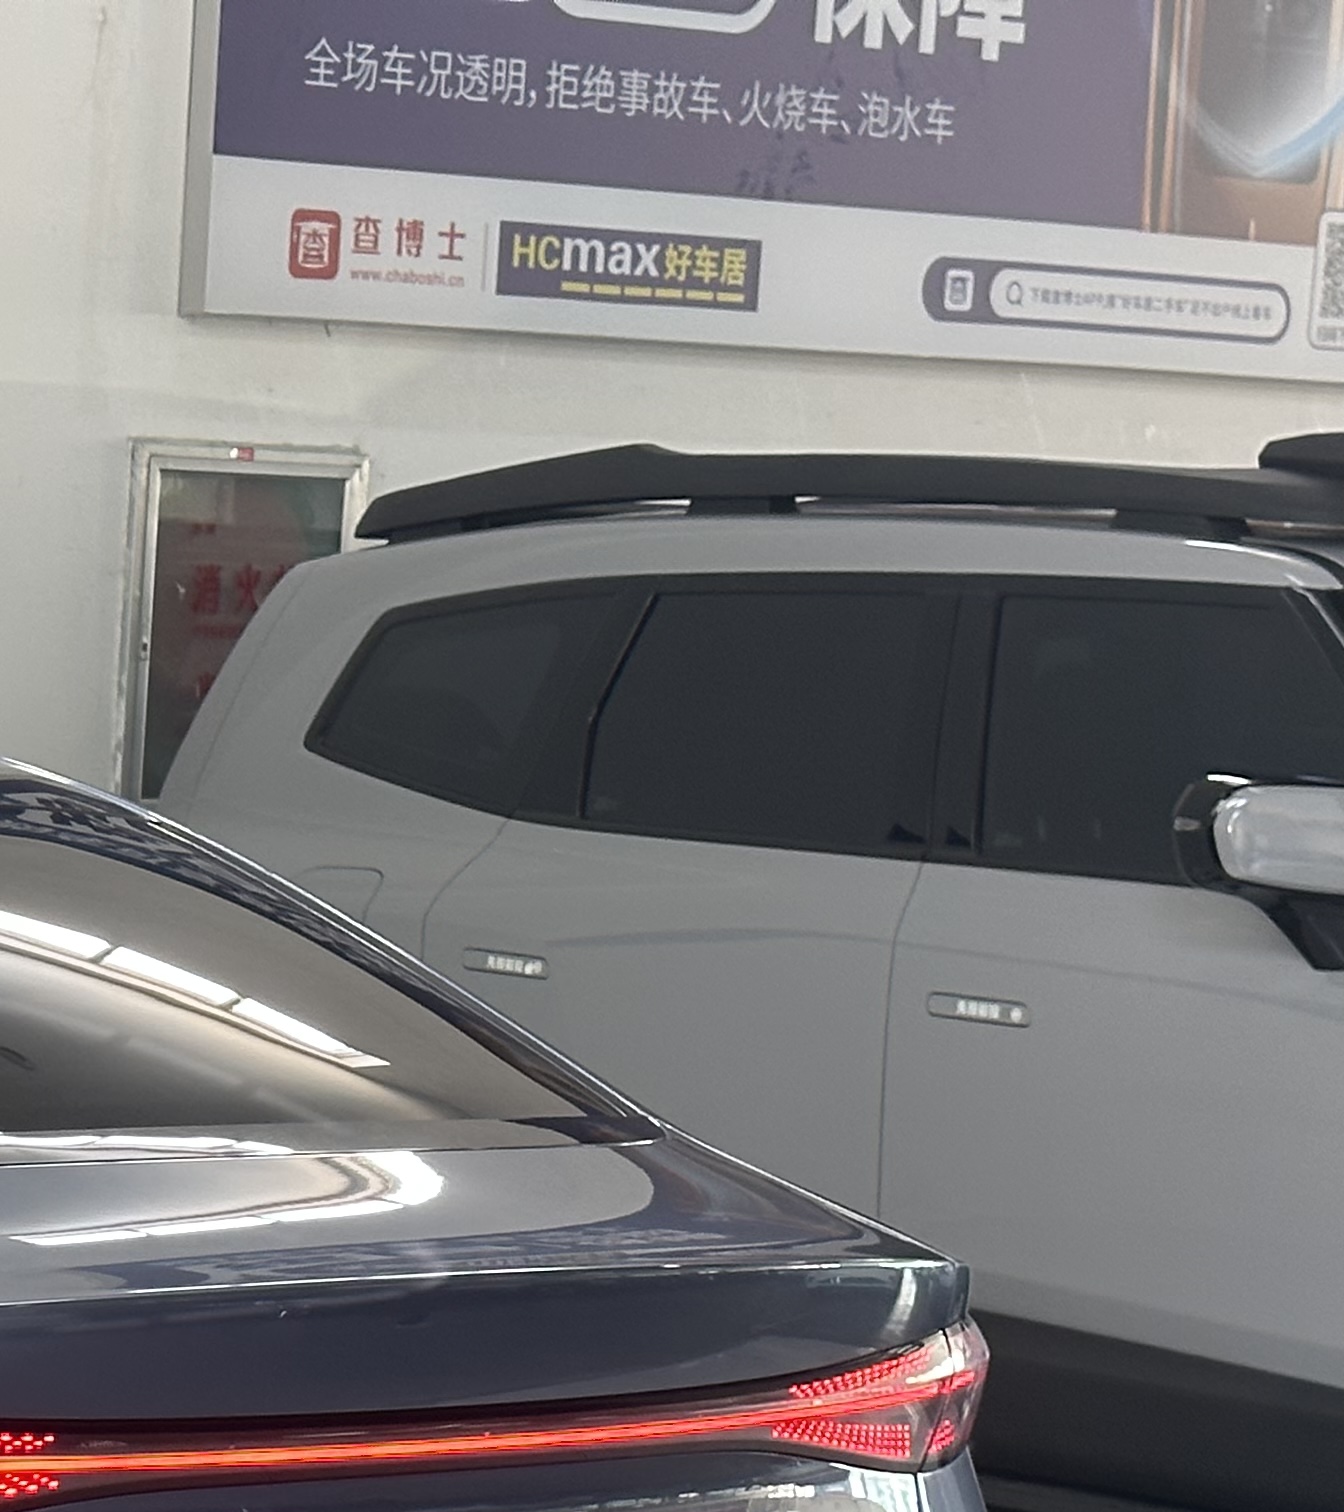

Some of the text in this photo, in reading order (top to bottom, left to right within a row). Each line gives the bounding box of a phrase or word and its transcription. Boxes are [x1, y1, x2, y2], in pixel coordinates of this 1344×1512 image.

[352, 215, 467, 263] 查博士
[350, 267, 466, 288] www.chaboshi.cn
